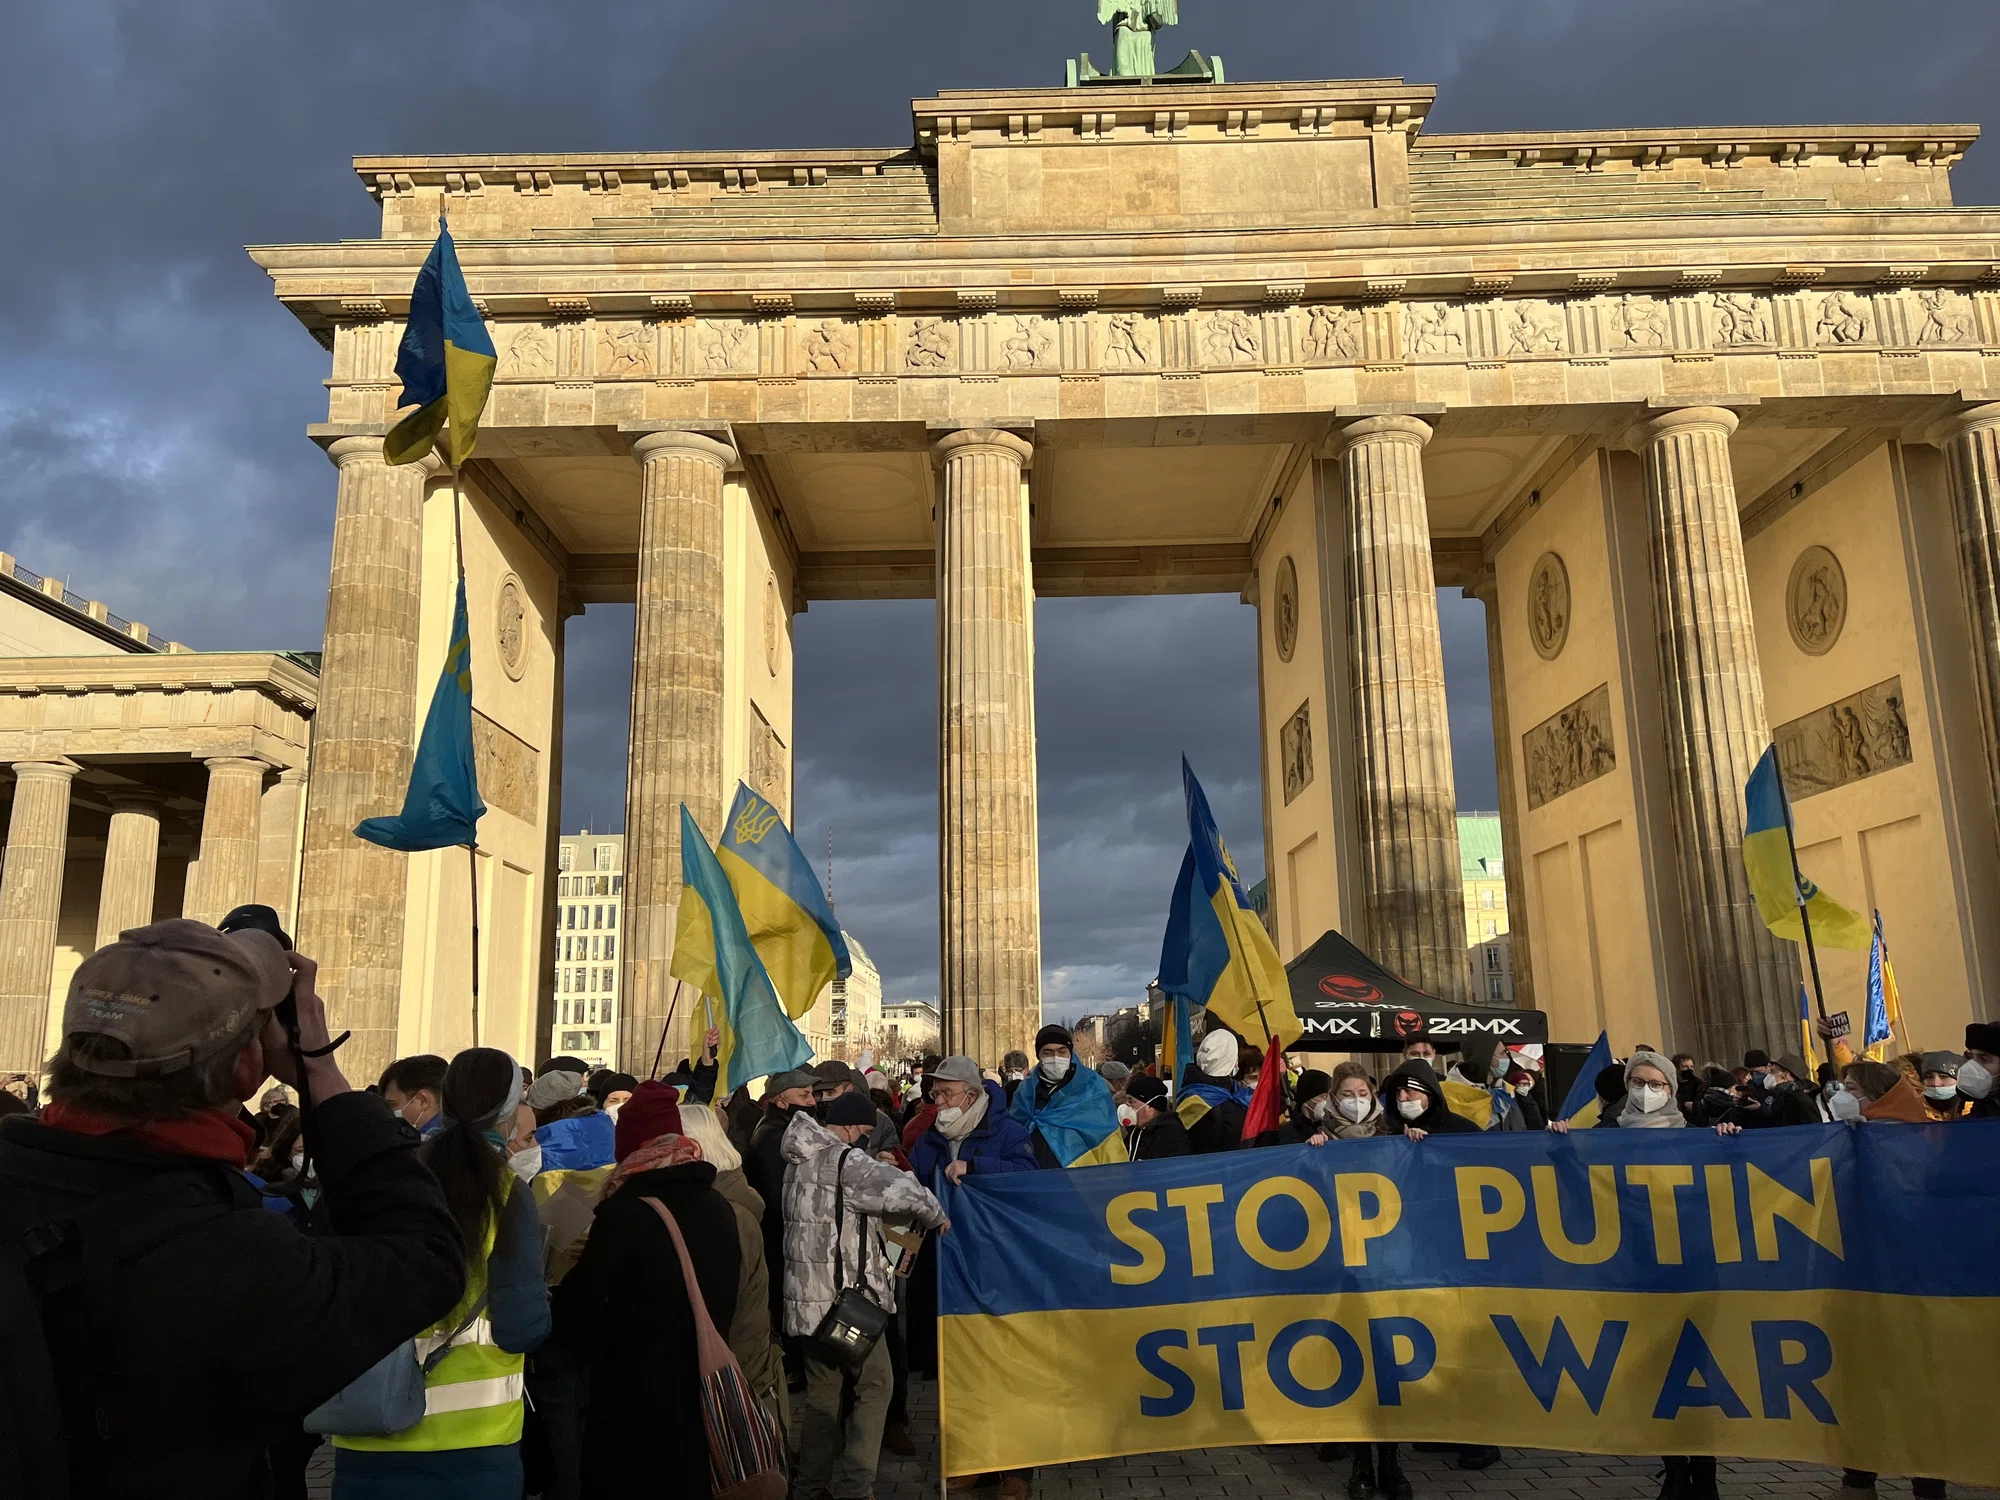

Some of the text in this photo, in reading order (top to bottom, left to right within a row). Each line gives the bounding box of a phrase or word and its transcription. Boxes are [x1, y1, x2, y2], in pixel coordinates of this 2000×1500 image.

[88, 1008, 123, 1020] TEAM
[1314, 1000, 1415, 1011] 24MX
[1428, 1018, 1524, 1036] 24MX
[1105, 1157, 1845, 1285] STOP PUTIN
[1135, 1314, 1840, 1426] STOP WAR
